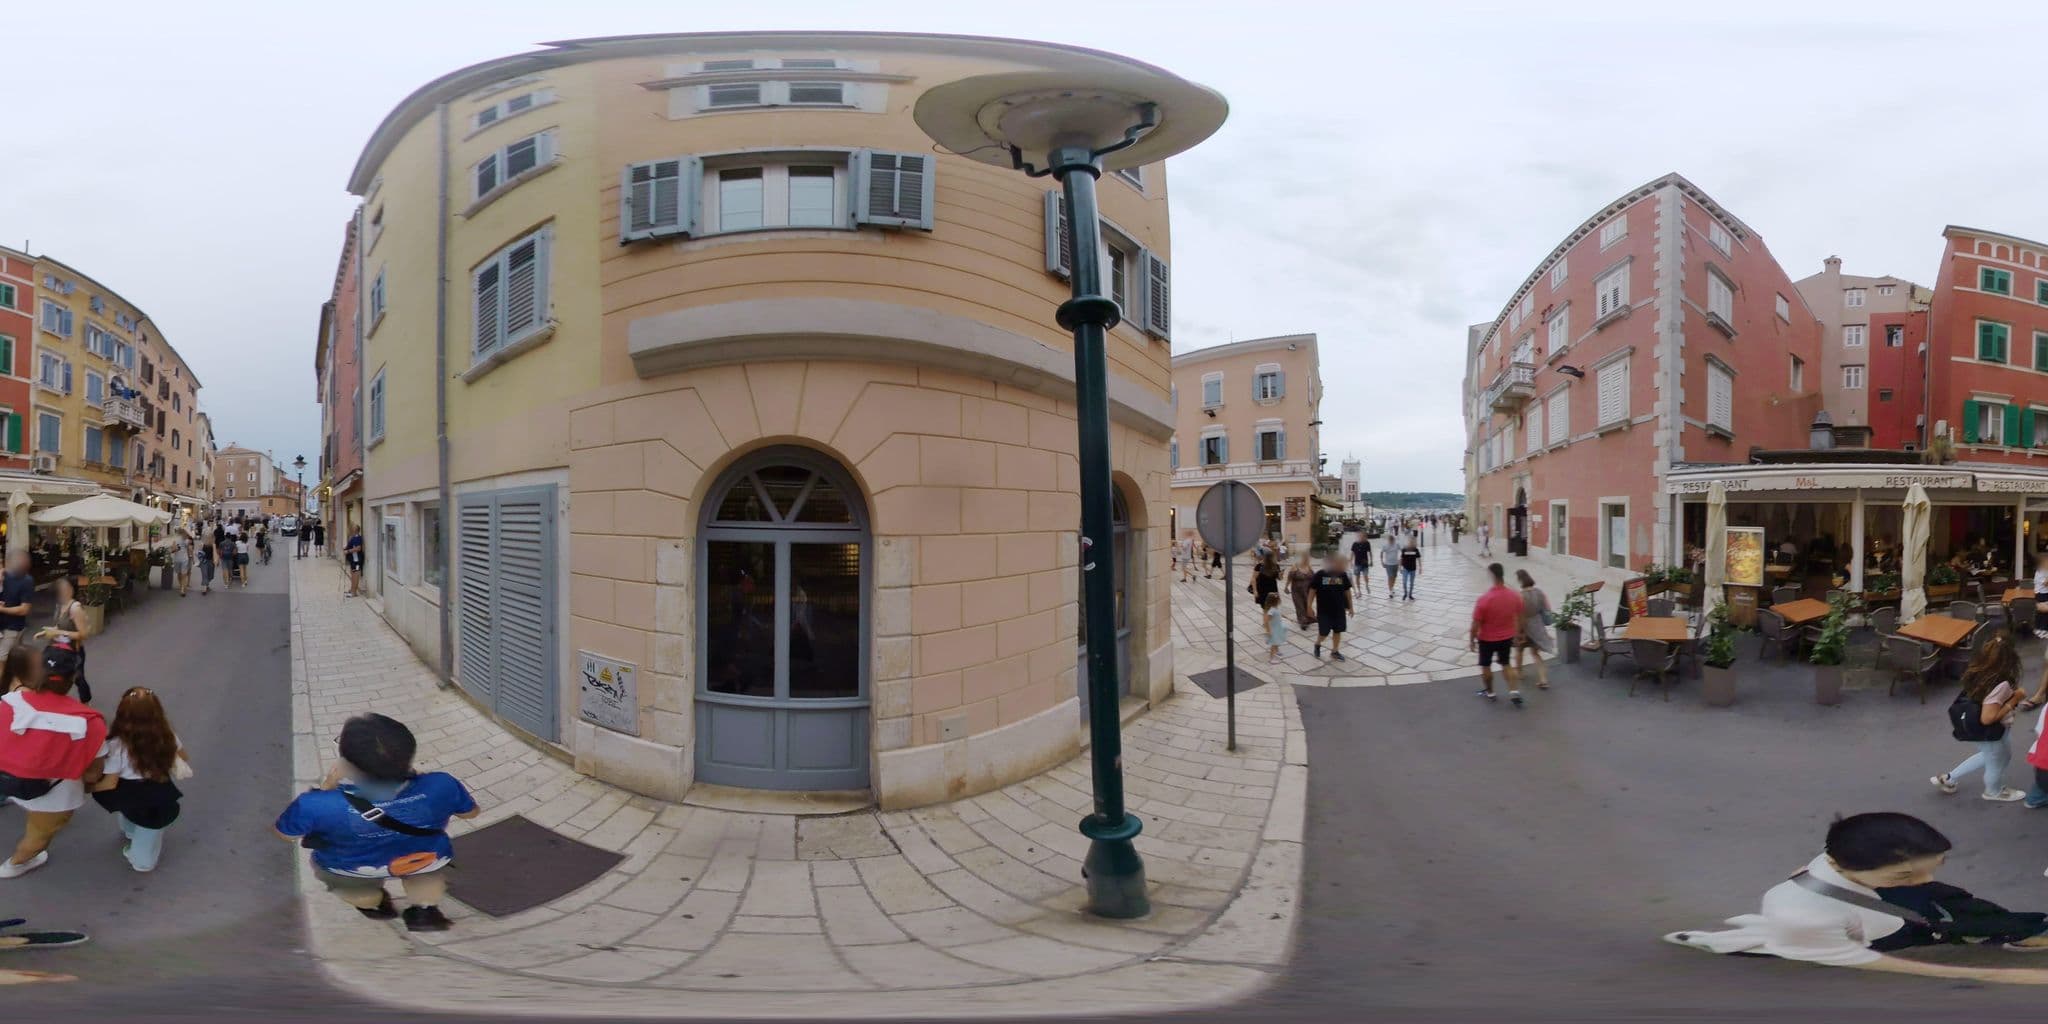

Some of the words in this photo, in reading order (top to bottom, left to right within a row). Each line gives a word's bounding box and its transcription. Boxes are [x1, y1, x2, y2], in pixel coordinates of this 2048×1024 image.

[1683, 480, 1749, 491] RESTARANT
[1796, 477, 1818, 487] M&L
[1886, 476, 1954, 486] RESTAURANT
[1994, 480, 2046, 490] RESTAURANT
